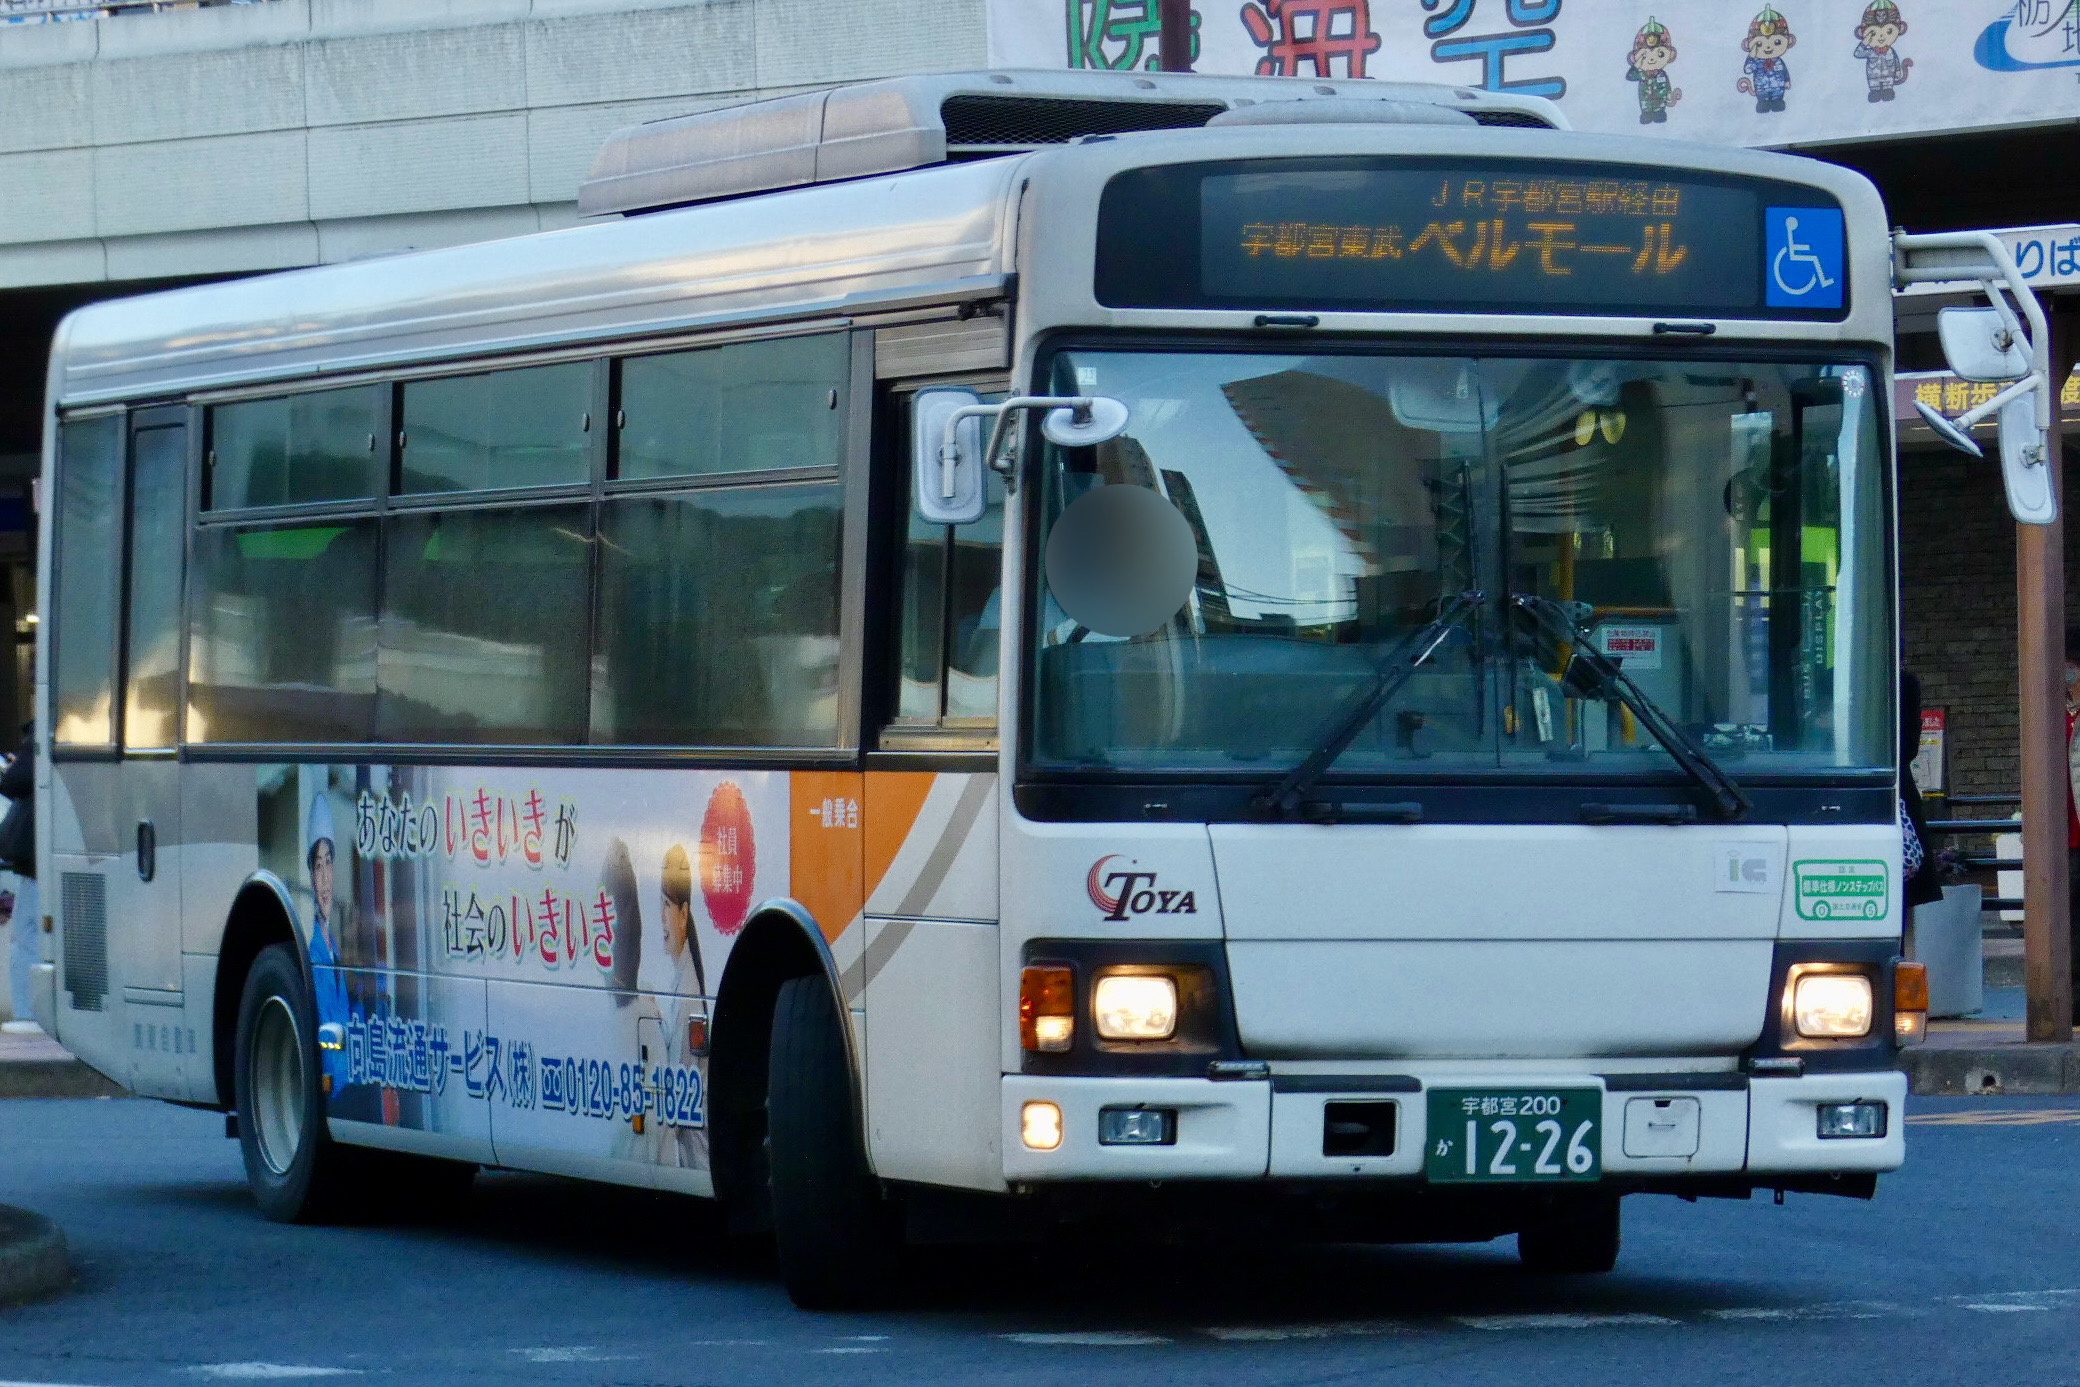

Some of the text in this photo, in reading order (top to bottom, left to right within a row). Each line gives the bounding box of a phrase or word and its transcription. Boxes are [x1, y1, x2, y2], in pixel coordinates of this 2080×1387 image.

[1409, 219, 1688, 275] ベルモール
[809, 797, 859, 828] 一般乗合
[444, 888, 615, 968] 社会のいきいき
[1466, 1119, 1594, 1175] 12-26
